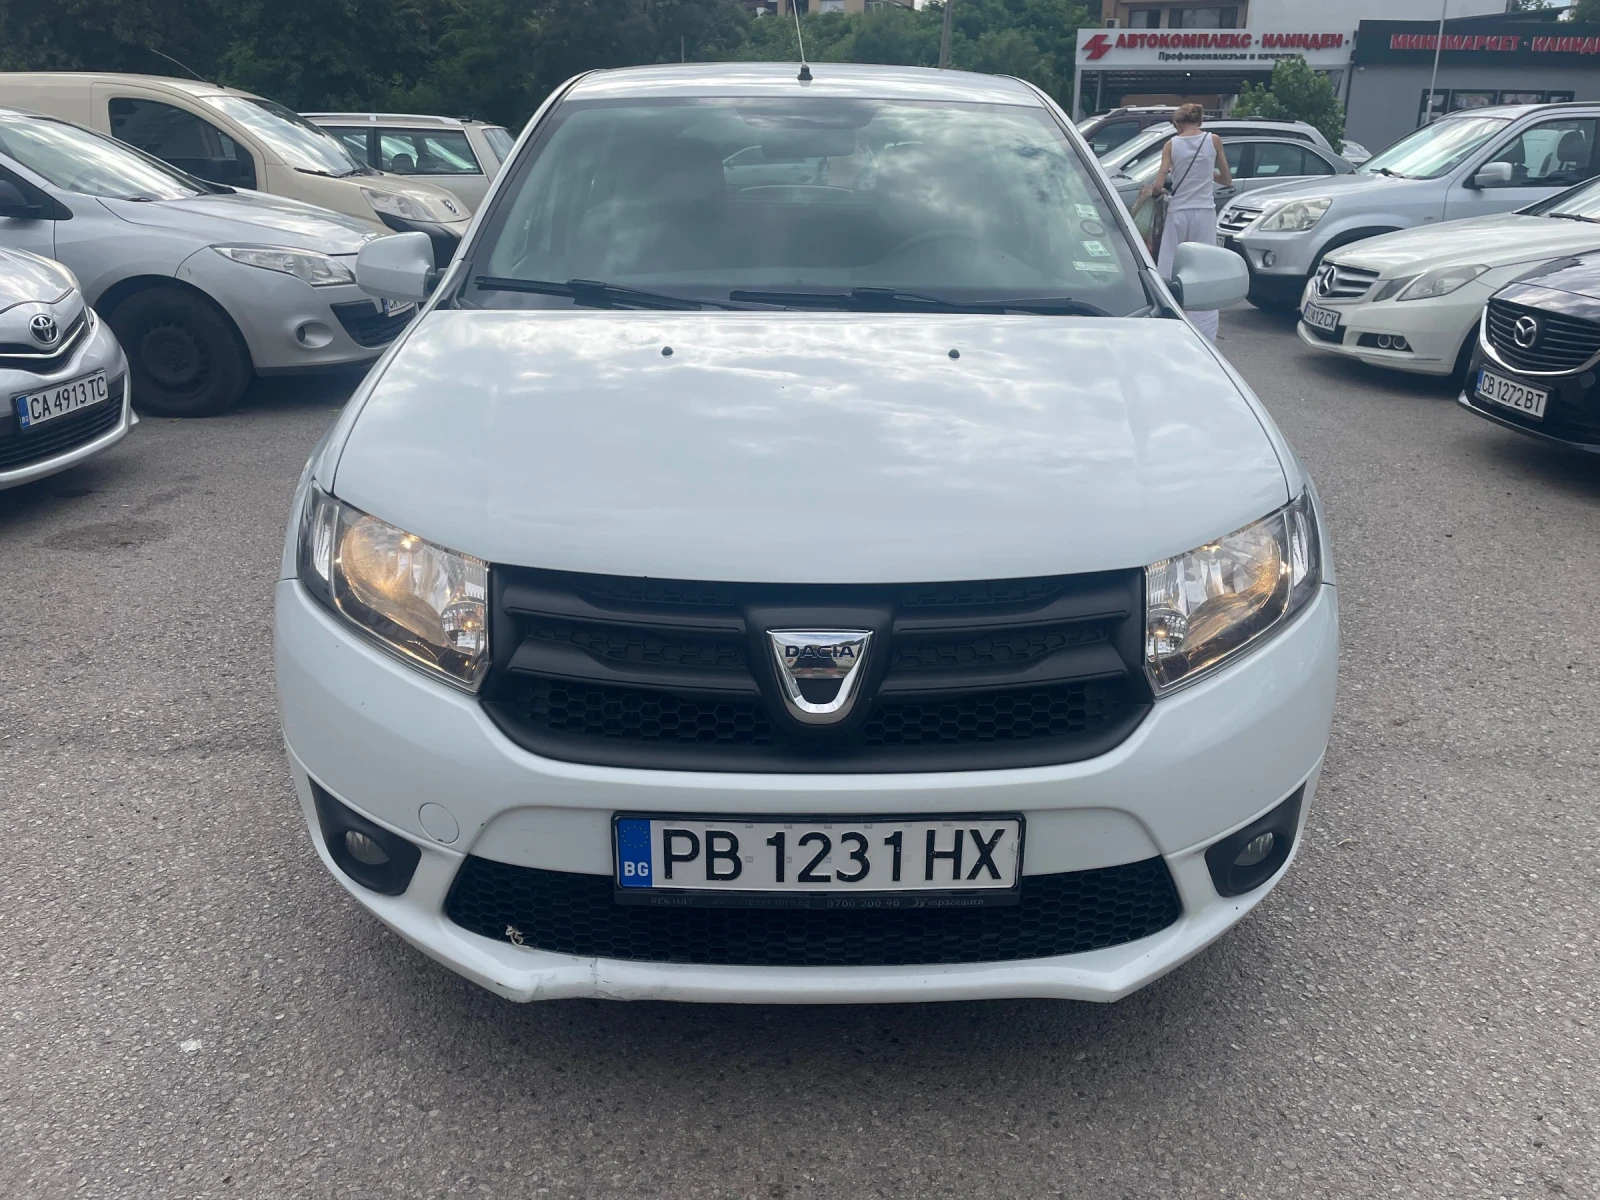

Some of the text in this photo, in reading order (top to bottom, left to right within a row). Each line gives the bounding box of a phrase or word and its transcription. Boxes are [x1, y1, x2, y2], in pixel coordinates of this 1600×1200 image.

[1115, 33, 1344, 50] АВТОКОМПЛЕКС ИЛИНДЕН
[1390, 34, 1521, 51] МИНИМАРКЕТ
[1324, 313, 1337, 329] CX
[30, 394, 52, 420] CA
[54, 383, 87, 412] 4913
[88, 376, 106, 401] TC
[1482, 374, 1544, 412] CB 1272 BT
[785, 644, 855, 658] DACIA
[624, 828, 1006, 883] BG PB 1231 HX
[827, 898, 856, 908] 0700
[861, 898, 881, 908] 200
[886, 898, 900, 908] 90
